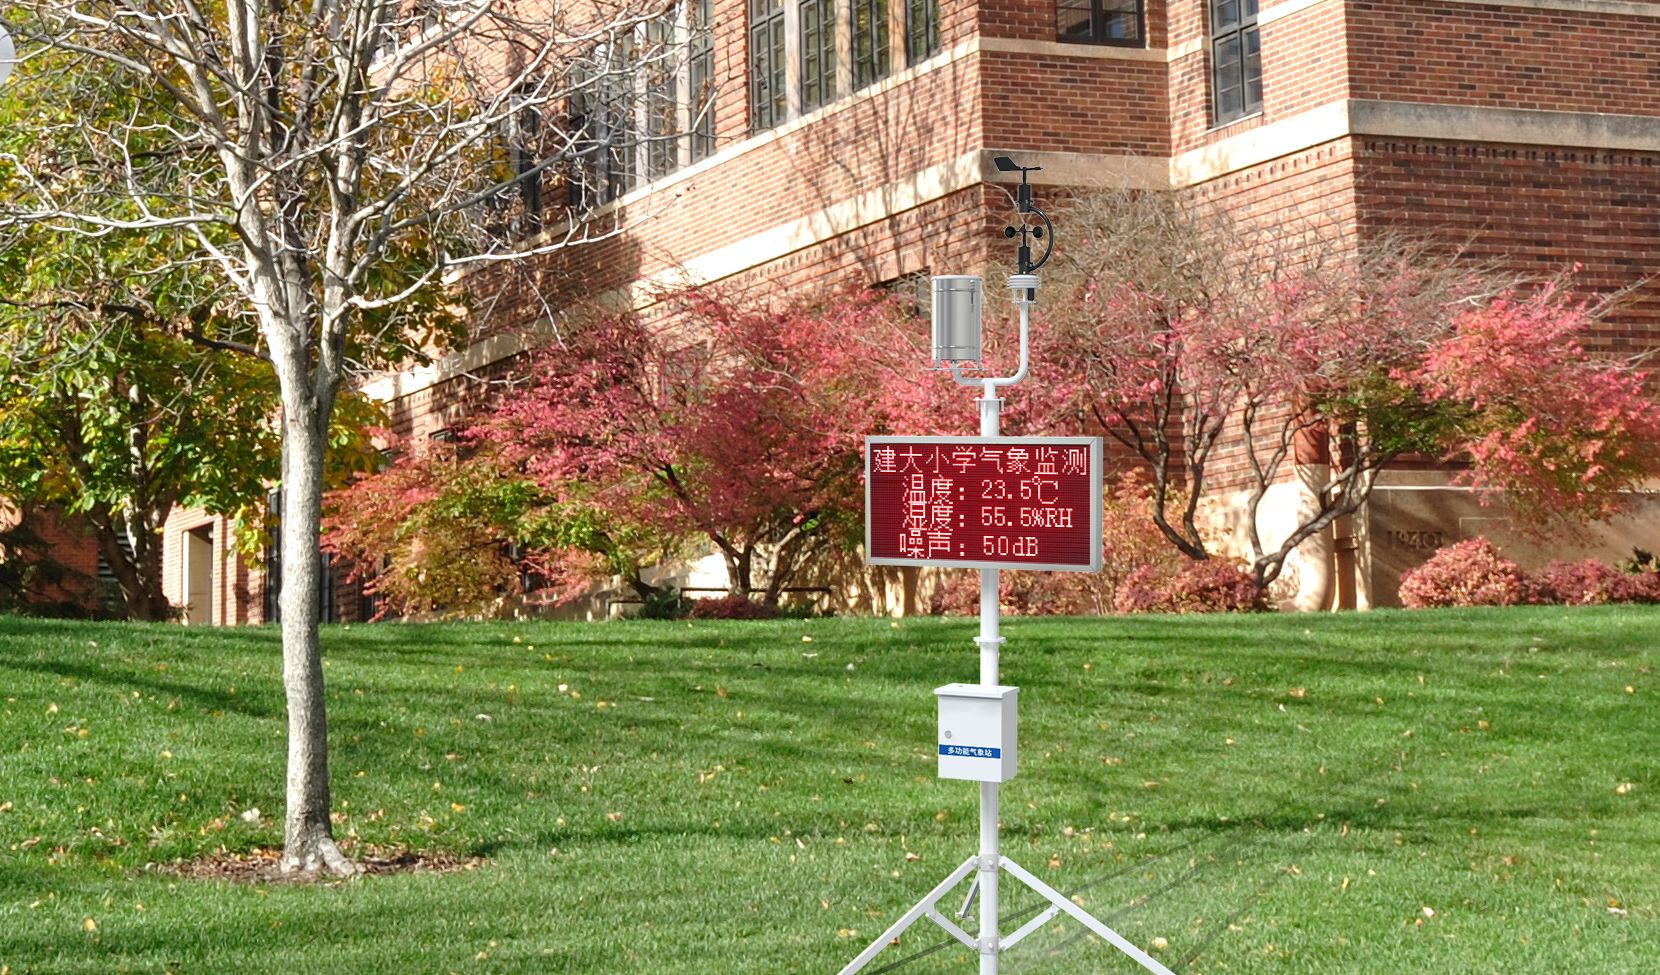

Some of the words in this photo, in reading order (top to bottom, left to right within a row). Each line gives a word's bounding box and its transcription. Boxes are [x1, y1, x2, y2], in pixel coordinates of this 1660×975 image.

[873, 446, 1087, 475] 建大小学气象监测
[947, 746, 992, 757] 多功能气象站
